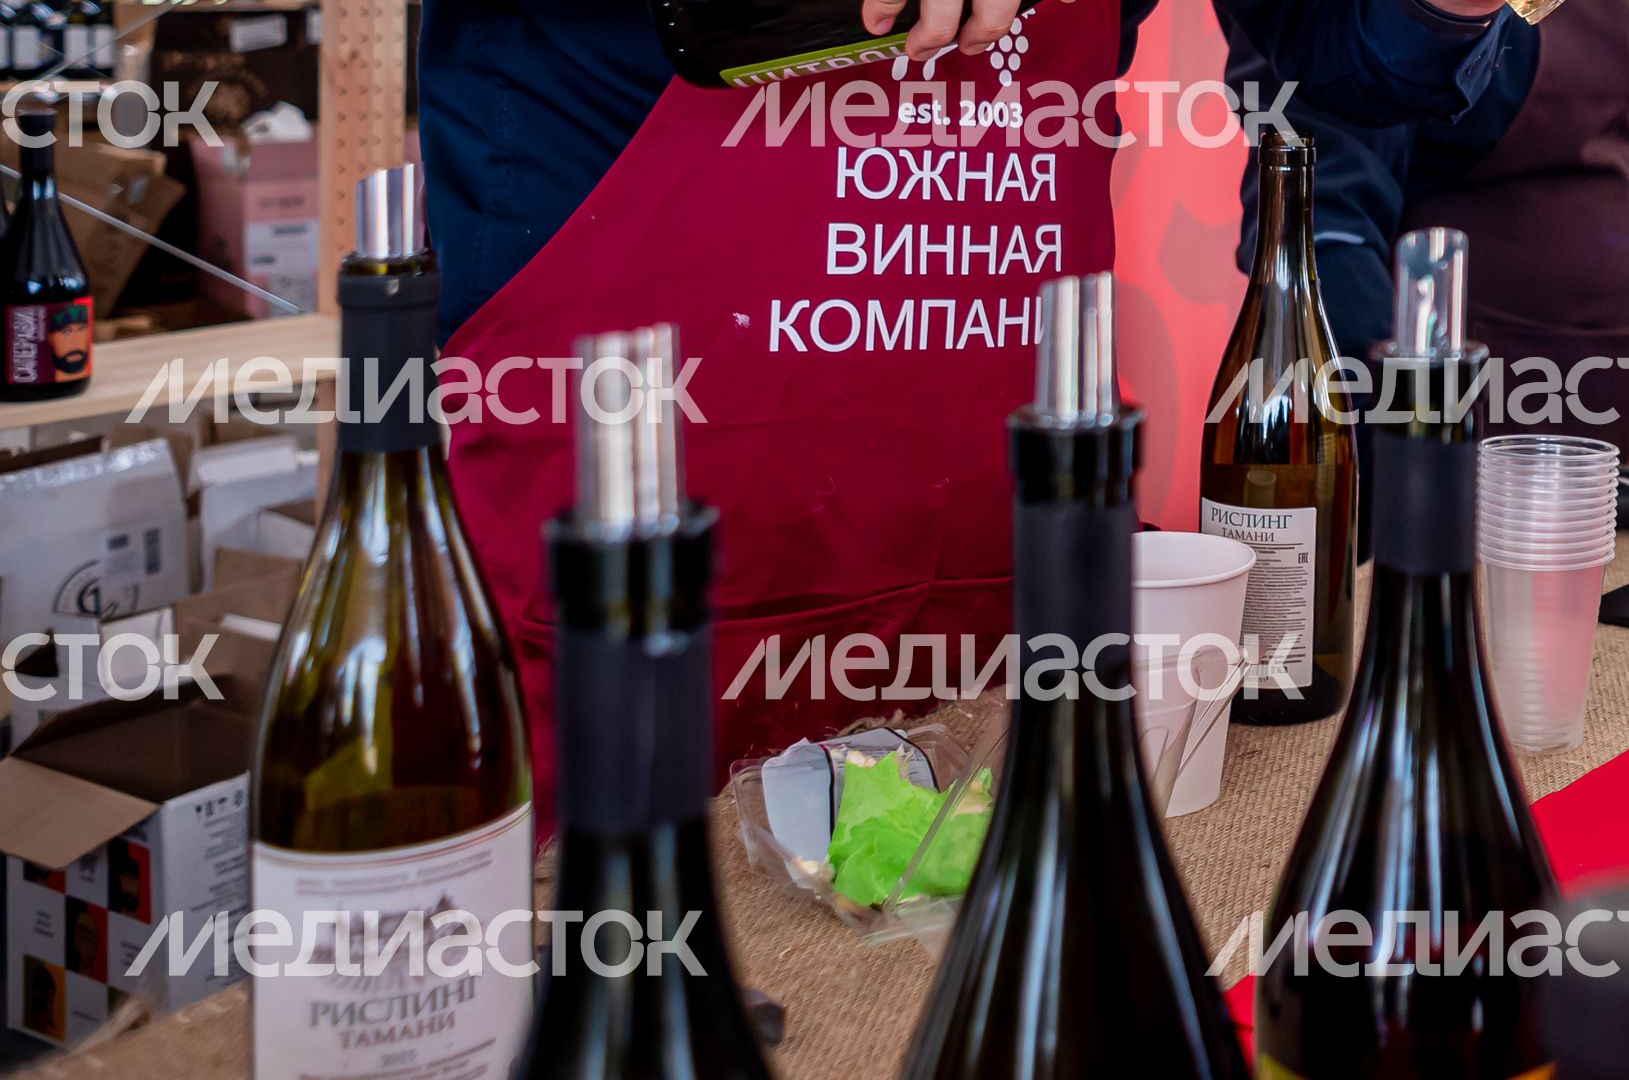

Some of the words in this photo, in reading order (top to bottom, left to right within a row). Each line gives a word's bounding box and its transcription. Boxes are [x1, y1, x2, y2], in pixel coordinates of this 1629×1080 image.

[898, 100, 950, 125] est.
[959, 100, 1023, 128] 2003
[836, 146, 1057, 202] ЮЖНАЯ
[826, 222, 1062, 277] ВИННАЯ
[1210, 507, 1292, 530] РИСЛИНГ
[1221, 527, 1275, 542] ТАМАНИ
[310, 976, 477, 1028] РИСЛИНГ
